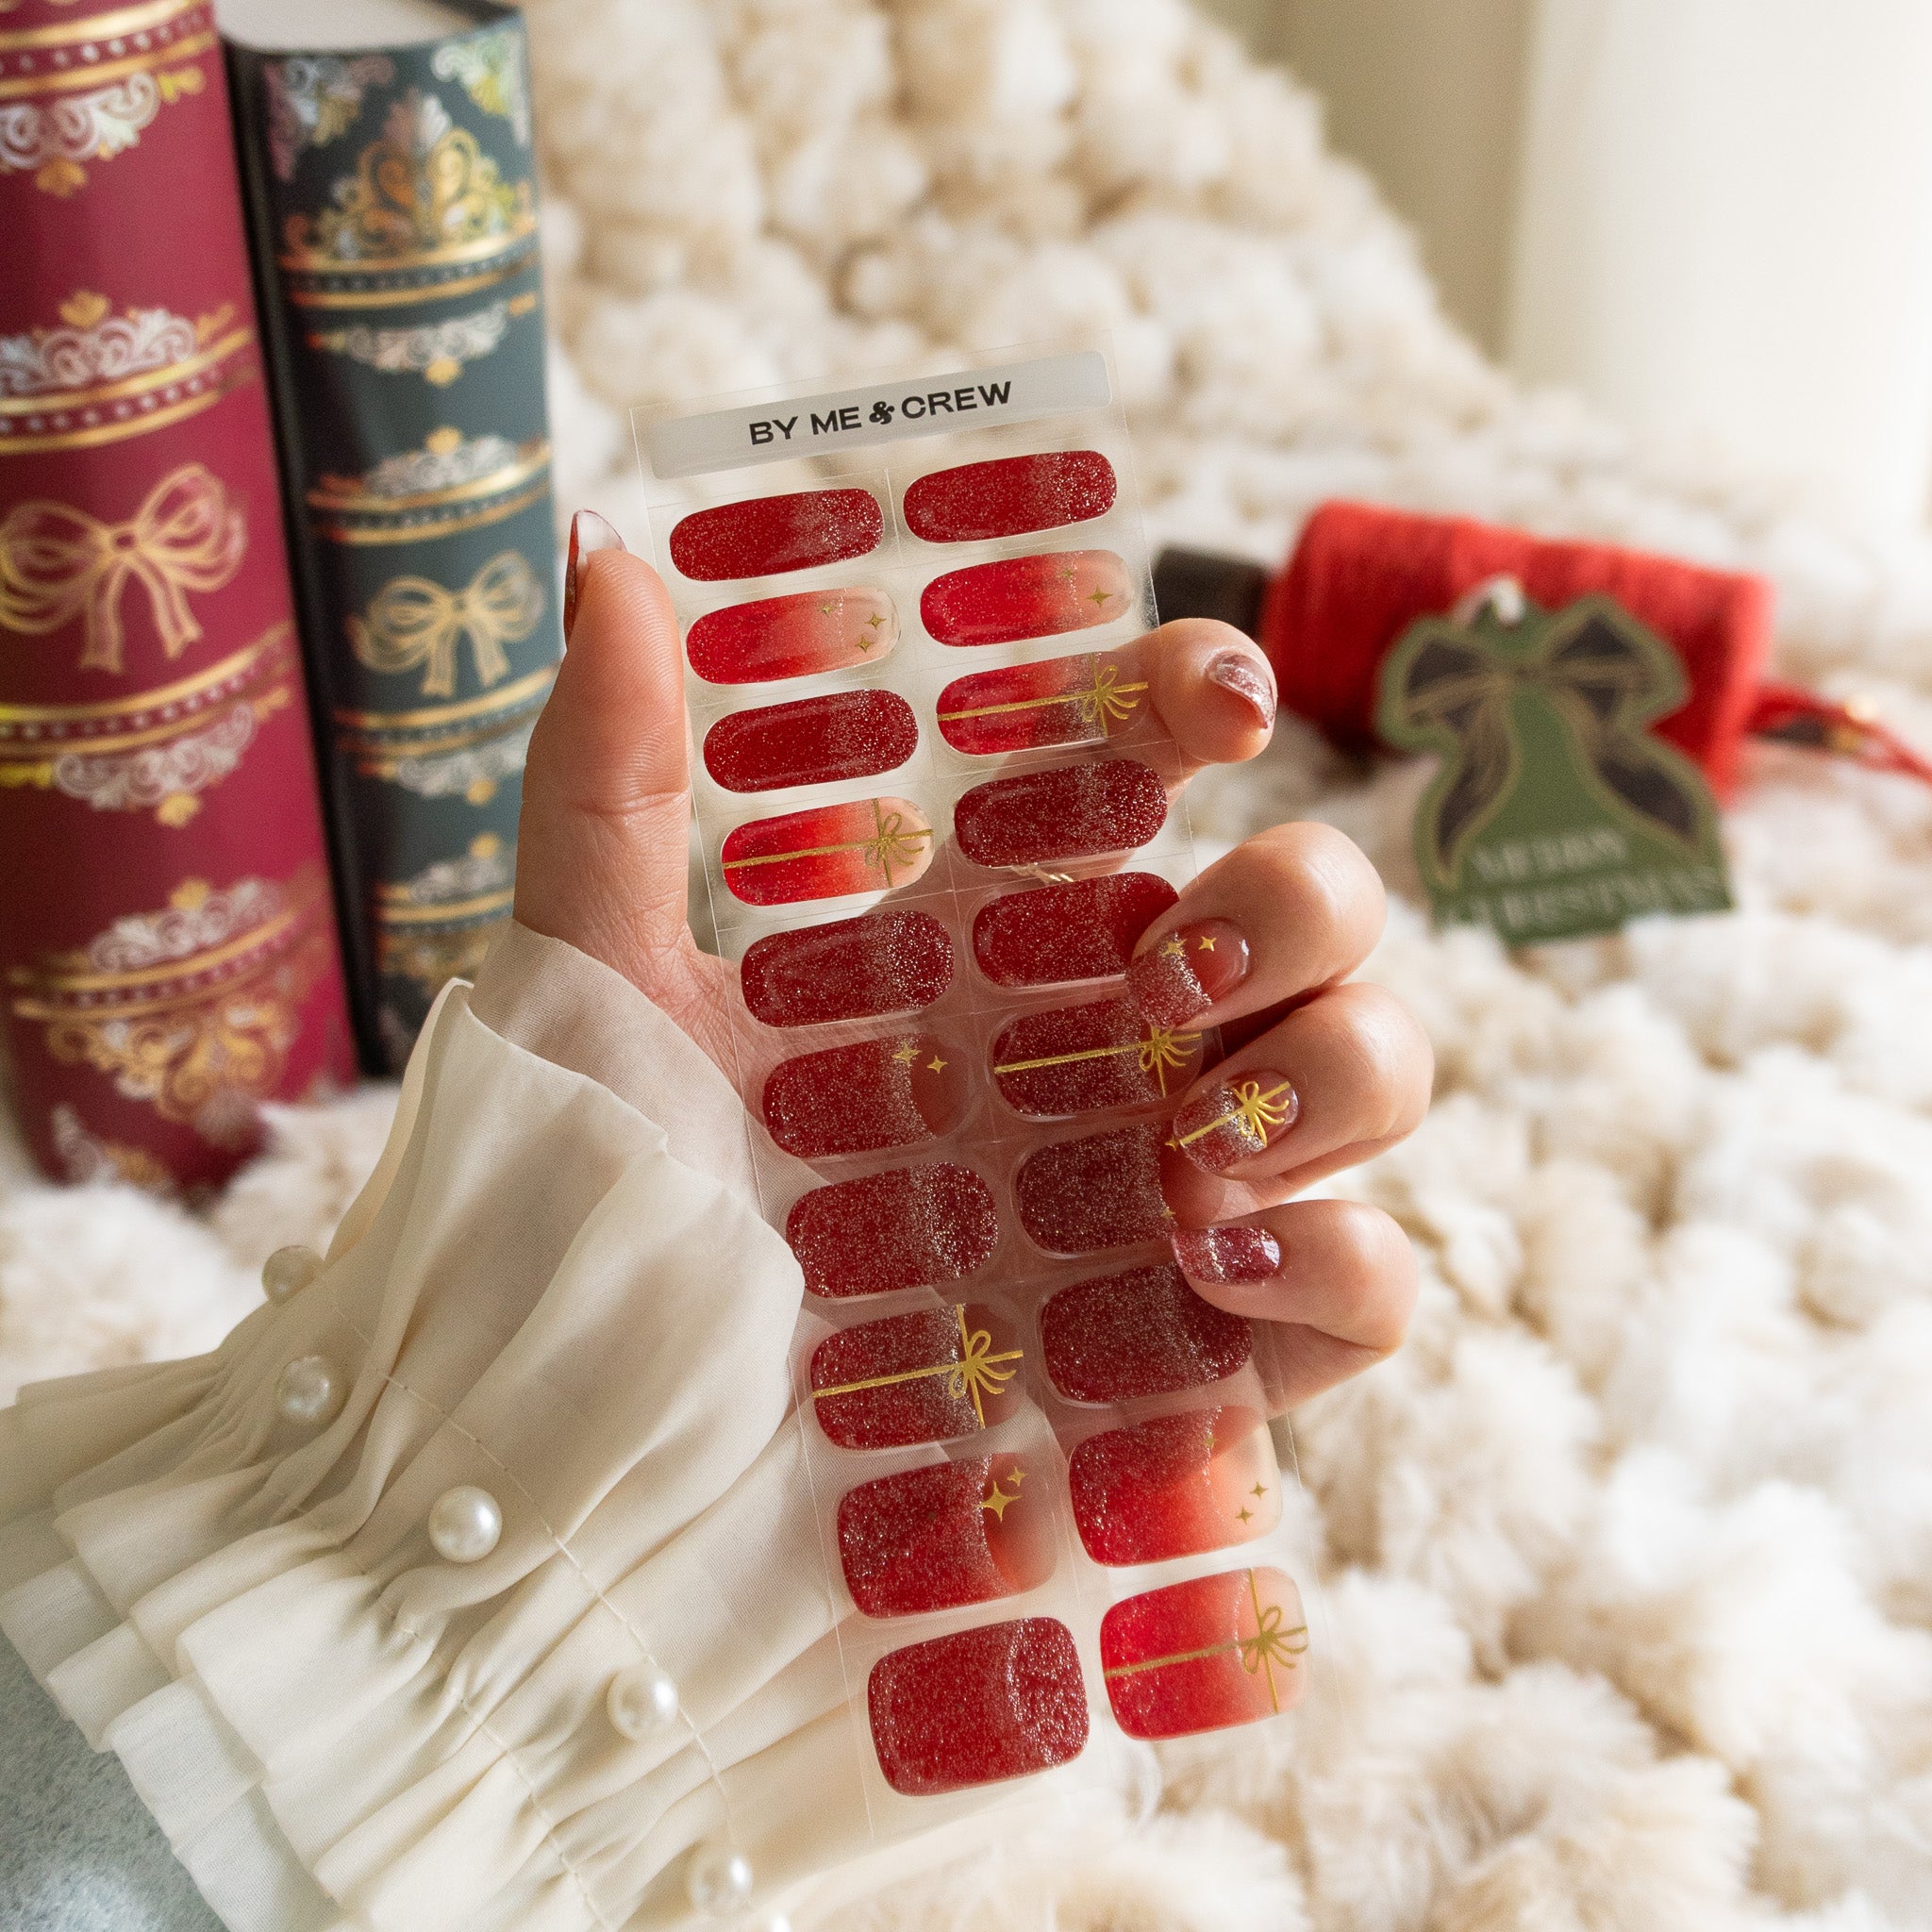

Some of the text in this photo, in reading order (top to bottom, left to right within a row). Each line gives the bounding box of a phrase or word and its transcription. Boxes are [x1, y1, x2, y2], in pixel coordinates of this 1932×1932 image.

[749, 380, 1011, 446] BY ME & CREW
